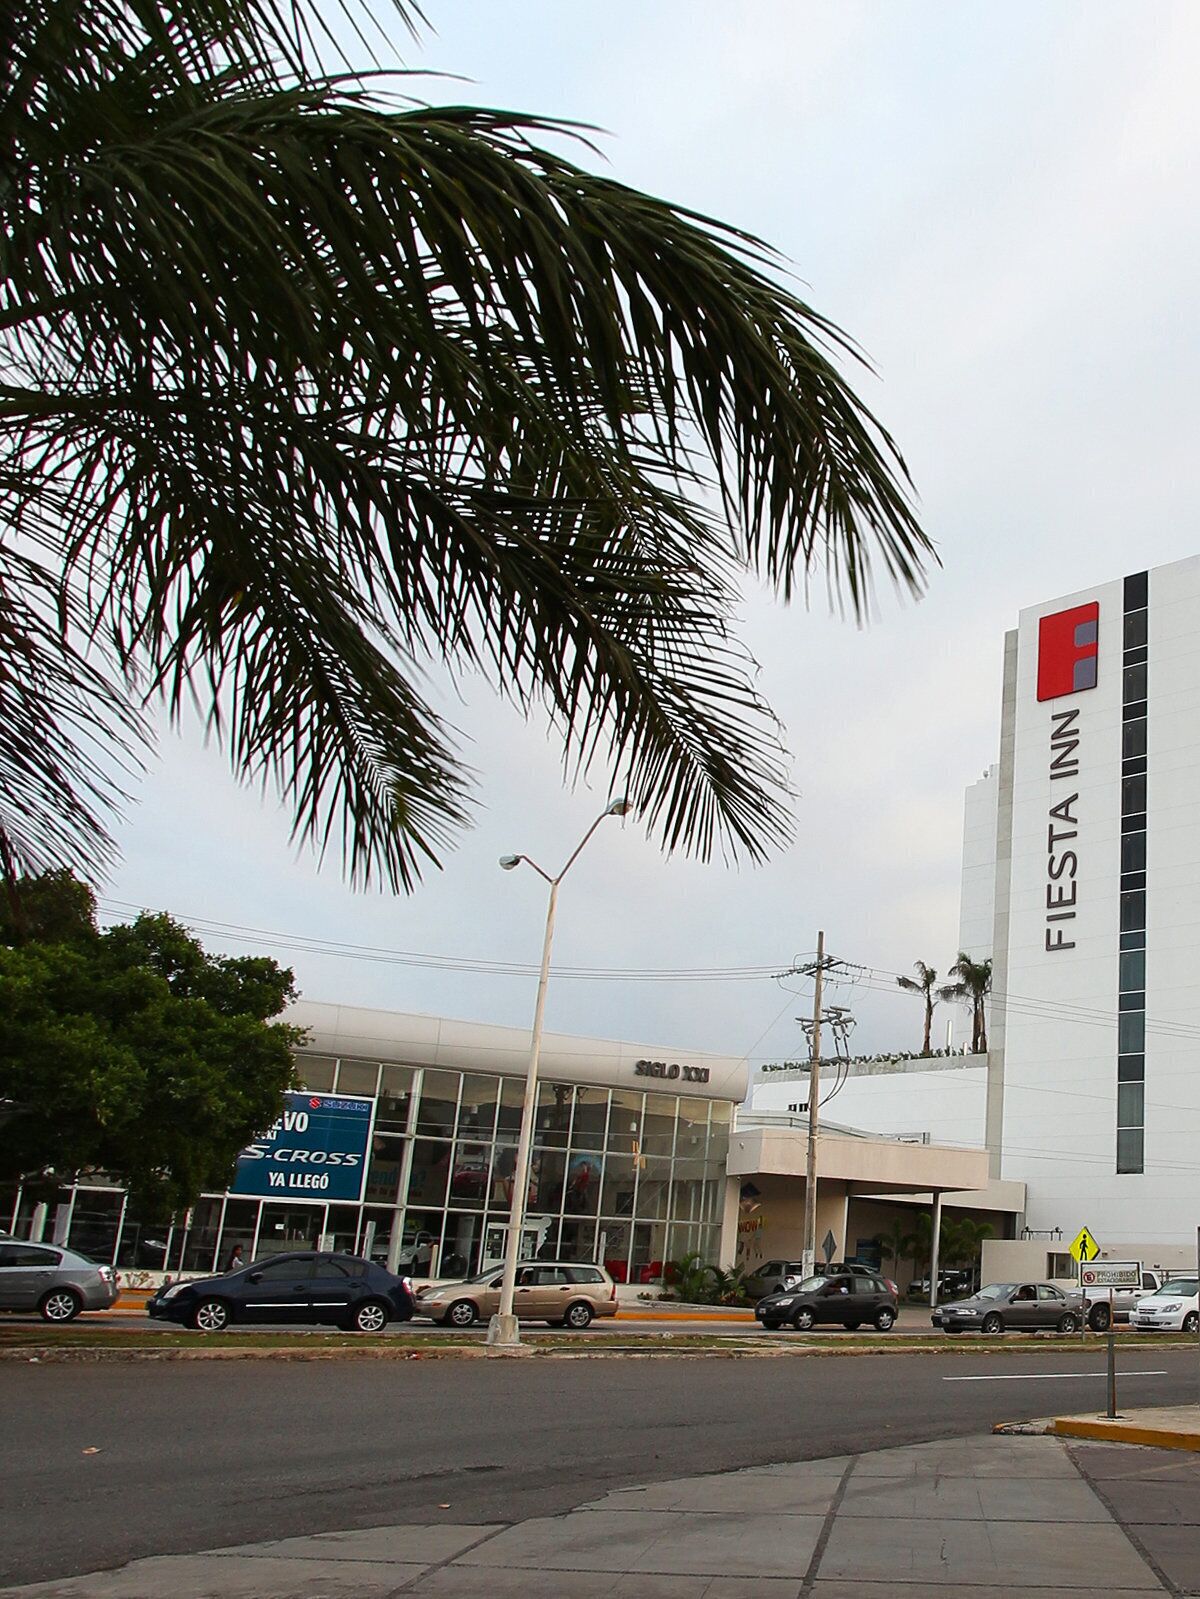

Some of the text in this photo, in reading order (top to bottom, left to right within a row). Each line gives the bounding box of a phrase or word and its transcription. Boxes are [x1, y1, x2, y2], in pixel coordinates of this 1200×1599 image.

[1046, 708, 1080, 952] FIESTA INN
[634, 1060, 710, 1083] SIGLO XXI
[323, 1100, 369, 1112] SUZUKI
[239, 1144, 362, 1166] S-CROSS
[268, 1172, 330, 1189] YA LLEGÓ
[1097, 1270, 1137, 1278] PROHIBIDO
